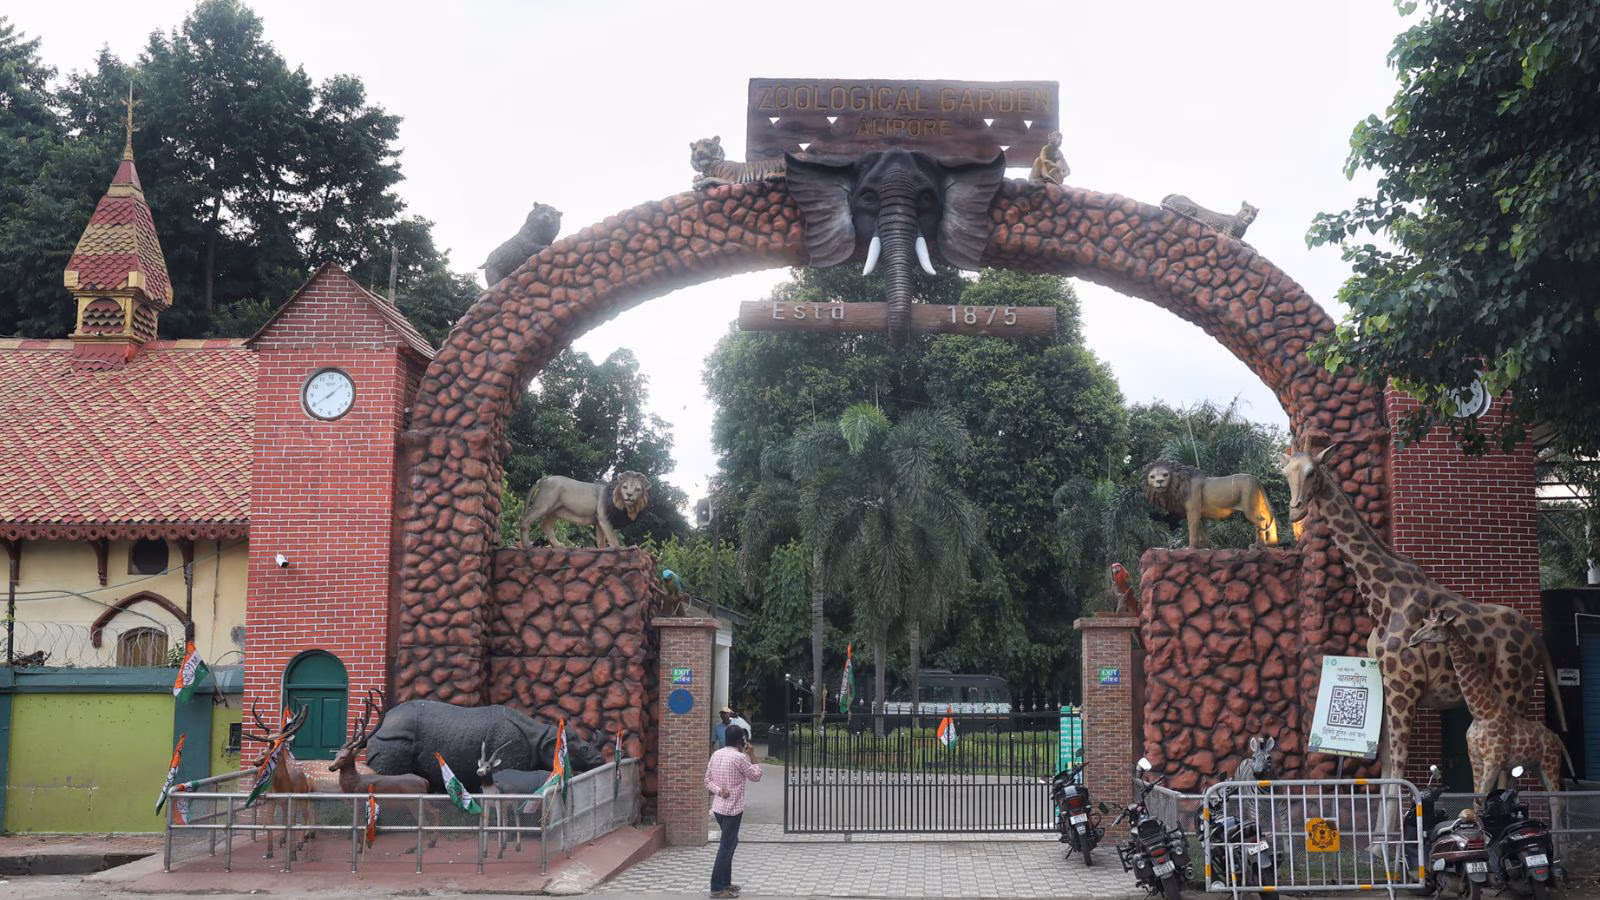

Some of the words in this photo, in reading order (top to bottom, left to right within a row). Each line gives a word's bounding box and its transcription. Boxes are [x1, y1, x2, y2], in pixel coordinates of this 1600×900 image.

[758, 84, 929, 112] ZOOLOGICAL
[940, 87, 1051, 113] GARDEN
[856, 117, 952, 136] ALIPORE
[772, 302, 845, 320] Estd
[947, 305, 1017, 326] 1875
